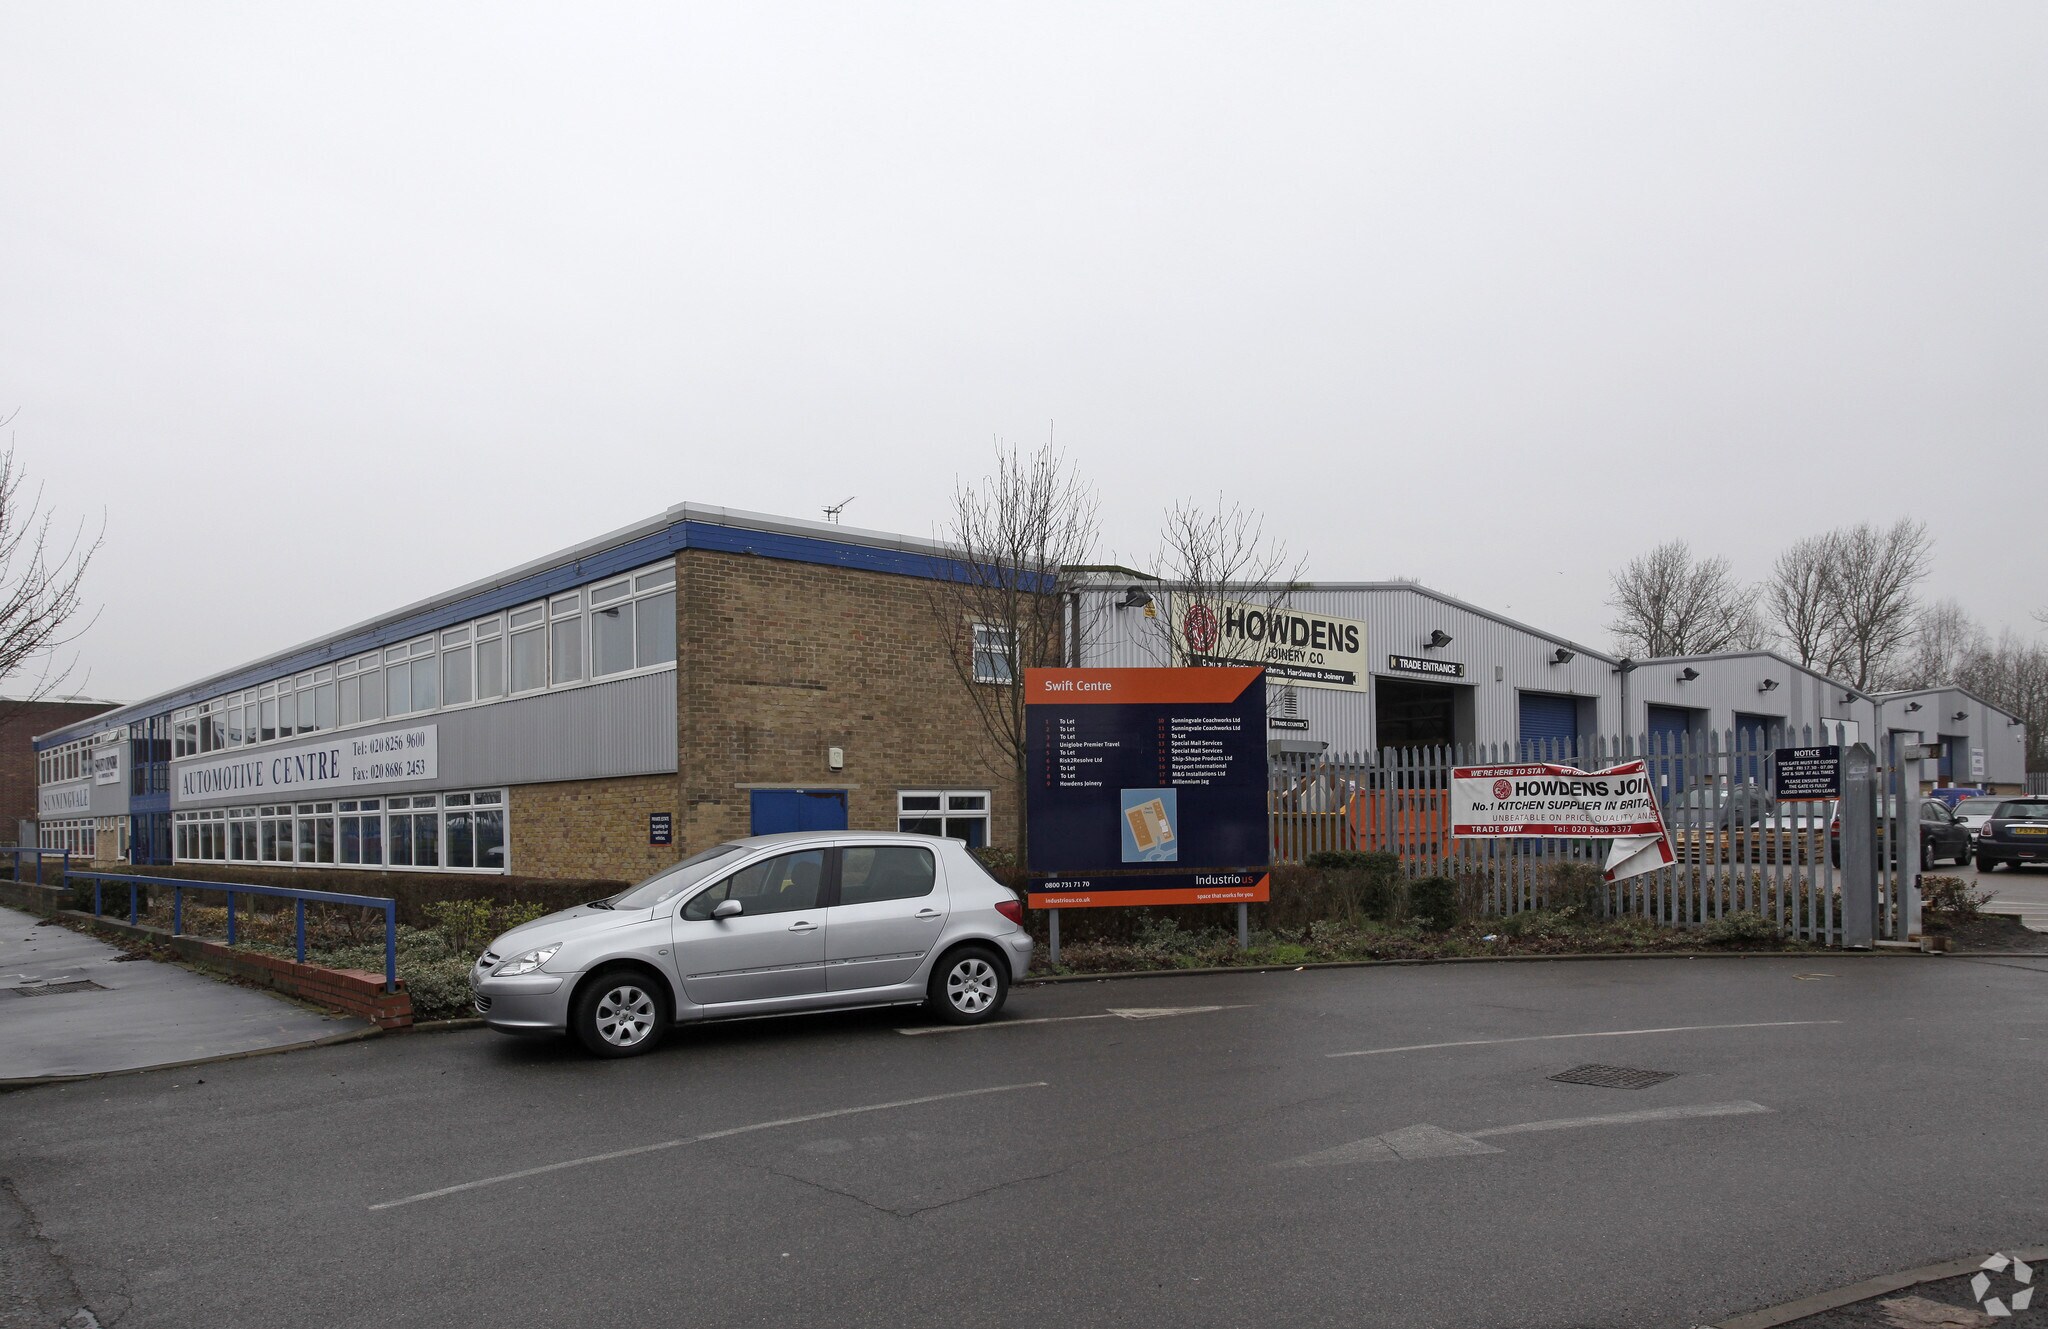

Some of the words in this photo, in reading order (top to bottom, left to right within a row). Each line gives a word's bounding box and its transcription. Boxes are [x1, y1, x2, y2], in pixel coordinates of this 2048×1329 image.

[1226, 607, 1359, 653] HOWDENS
[1266, 647, 1305, 663] JOINERY
[1310, 652, 1325, 665] CO.
[1400, 659, 1421, 669] TRADE
[1423, 662, 1455, 674] ENTRANCE
[1287, 669, 1316, 679] Hardware
[1324, 672, 1344, 682] Joinery
[1045, 681, 1073, 691] Swift
[1077, 681, 1112, 691] Centre
[353, 742, 367, 755] Tel:
[370, 738, 383, 753] 020
[385, 735, 403, 751] 8256
[407, 732, 425, 748] 9600
[183, 761, 263, 795] AUTOMOTIVE
[273, 750, 339, 784] CENTRE
[353, 767, 368, 780] Fax:
[371, 764, 383, 778] 020
[385, 762, 403, 777] 8686
[407, 759, 425, 775] 2453
[1516, 781, 1609, 796] HOWDENS
[44, 789, 88, 811] SUNNINGVALE
[1498, 801, 1544, 810] KITCHEN
[1548, 801, 1601, 810] SUPPLIER
[1605, 801, 1617, 810] IN
[1595, 813, 1634, 822] QUALITY
[1196, 874, 1254, 884] Industrious
